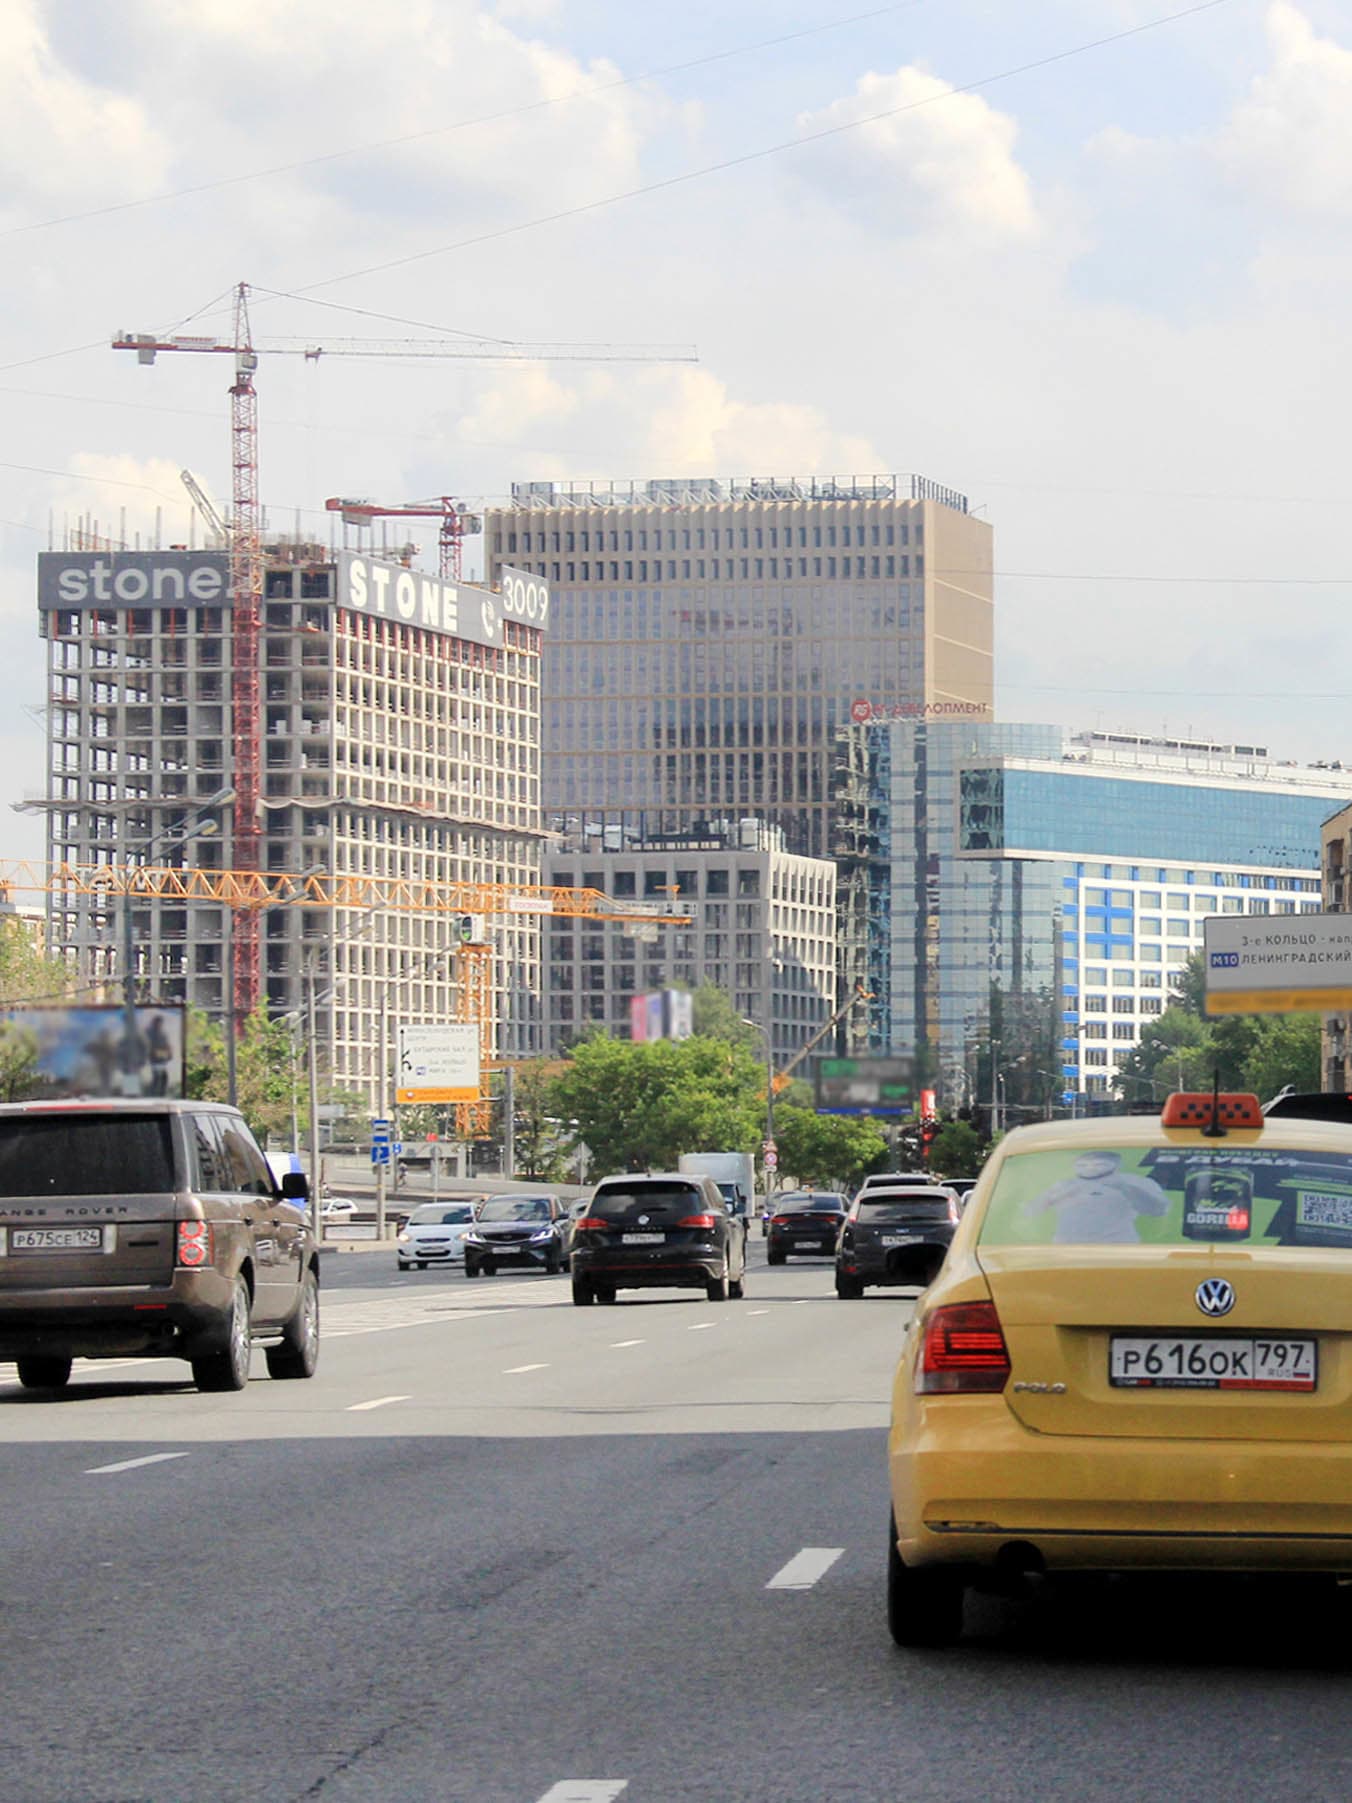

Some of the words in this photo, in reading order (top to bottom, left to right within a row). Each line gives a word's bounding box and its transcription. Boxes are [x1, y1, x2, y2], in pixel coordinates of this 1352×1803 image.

[350, 560, 458, 632] STONE
[1265, 934, 1317, 946] КОЛЬЦО
[1241, 950, 1351, 965] ЛЕНИНГРАДСКИЙ
[65, 1207, 128, 1216] ROVER
[1123, 1343, 1249, 1377] Р616ОК
[1256, 1343, 1305, 1369] 797
[1013, 1380, 1067, 1395] POLO
